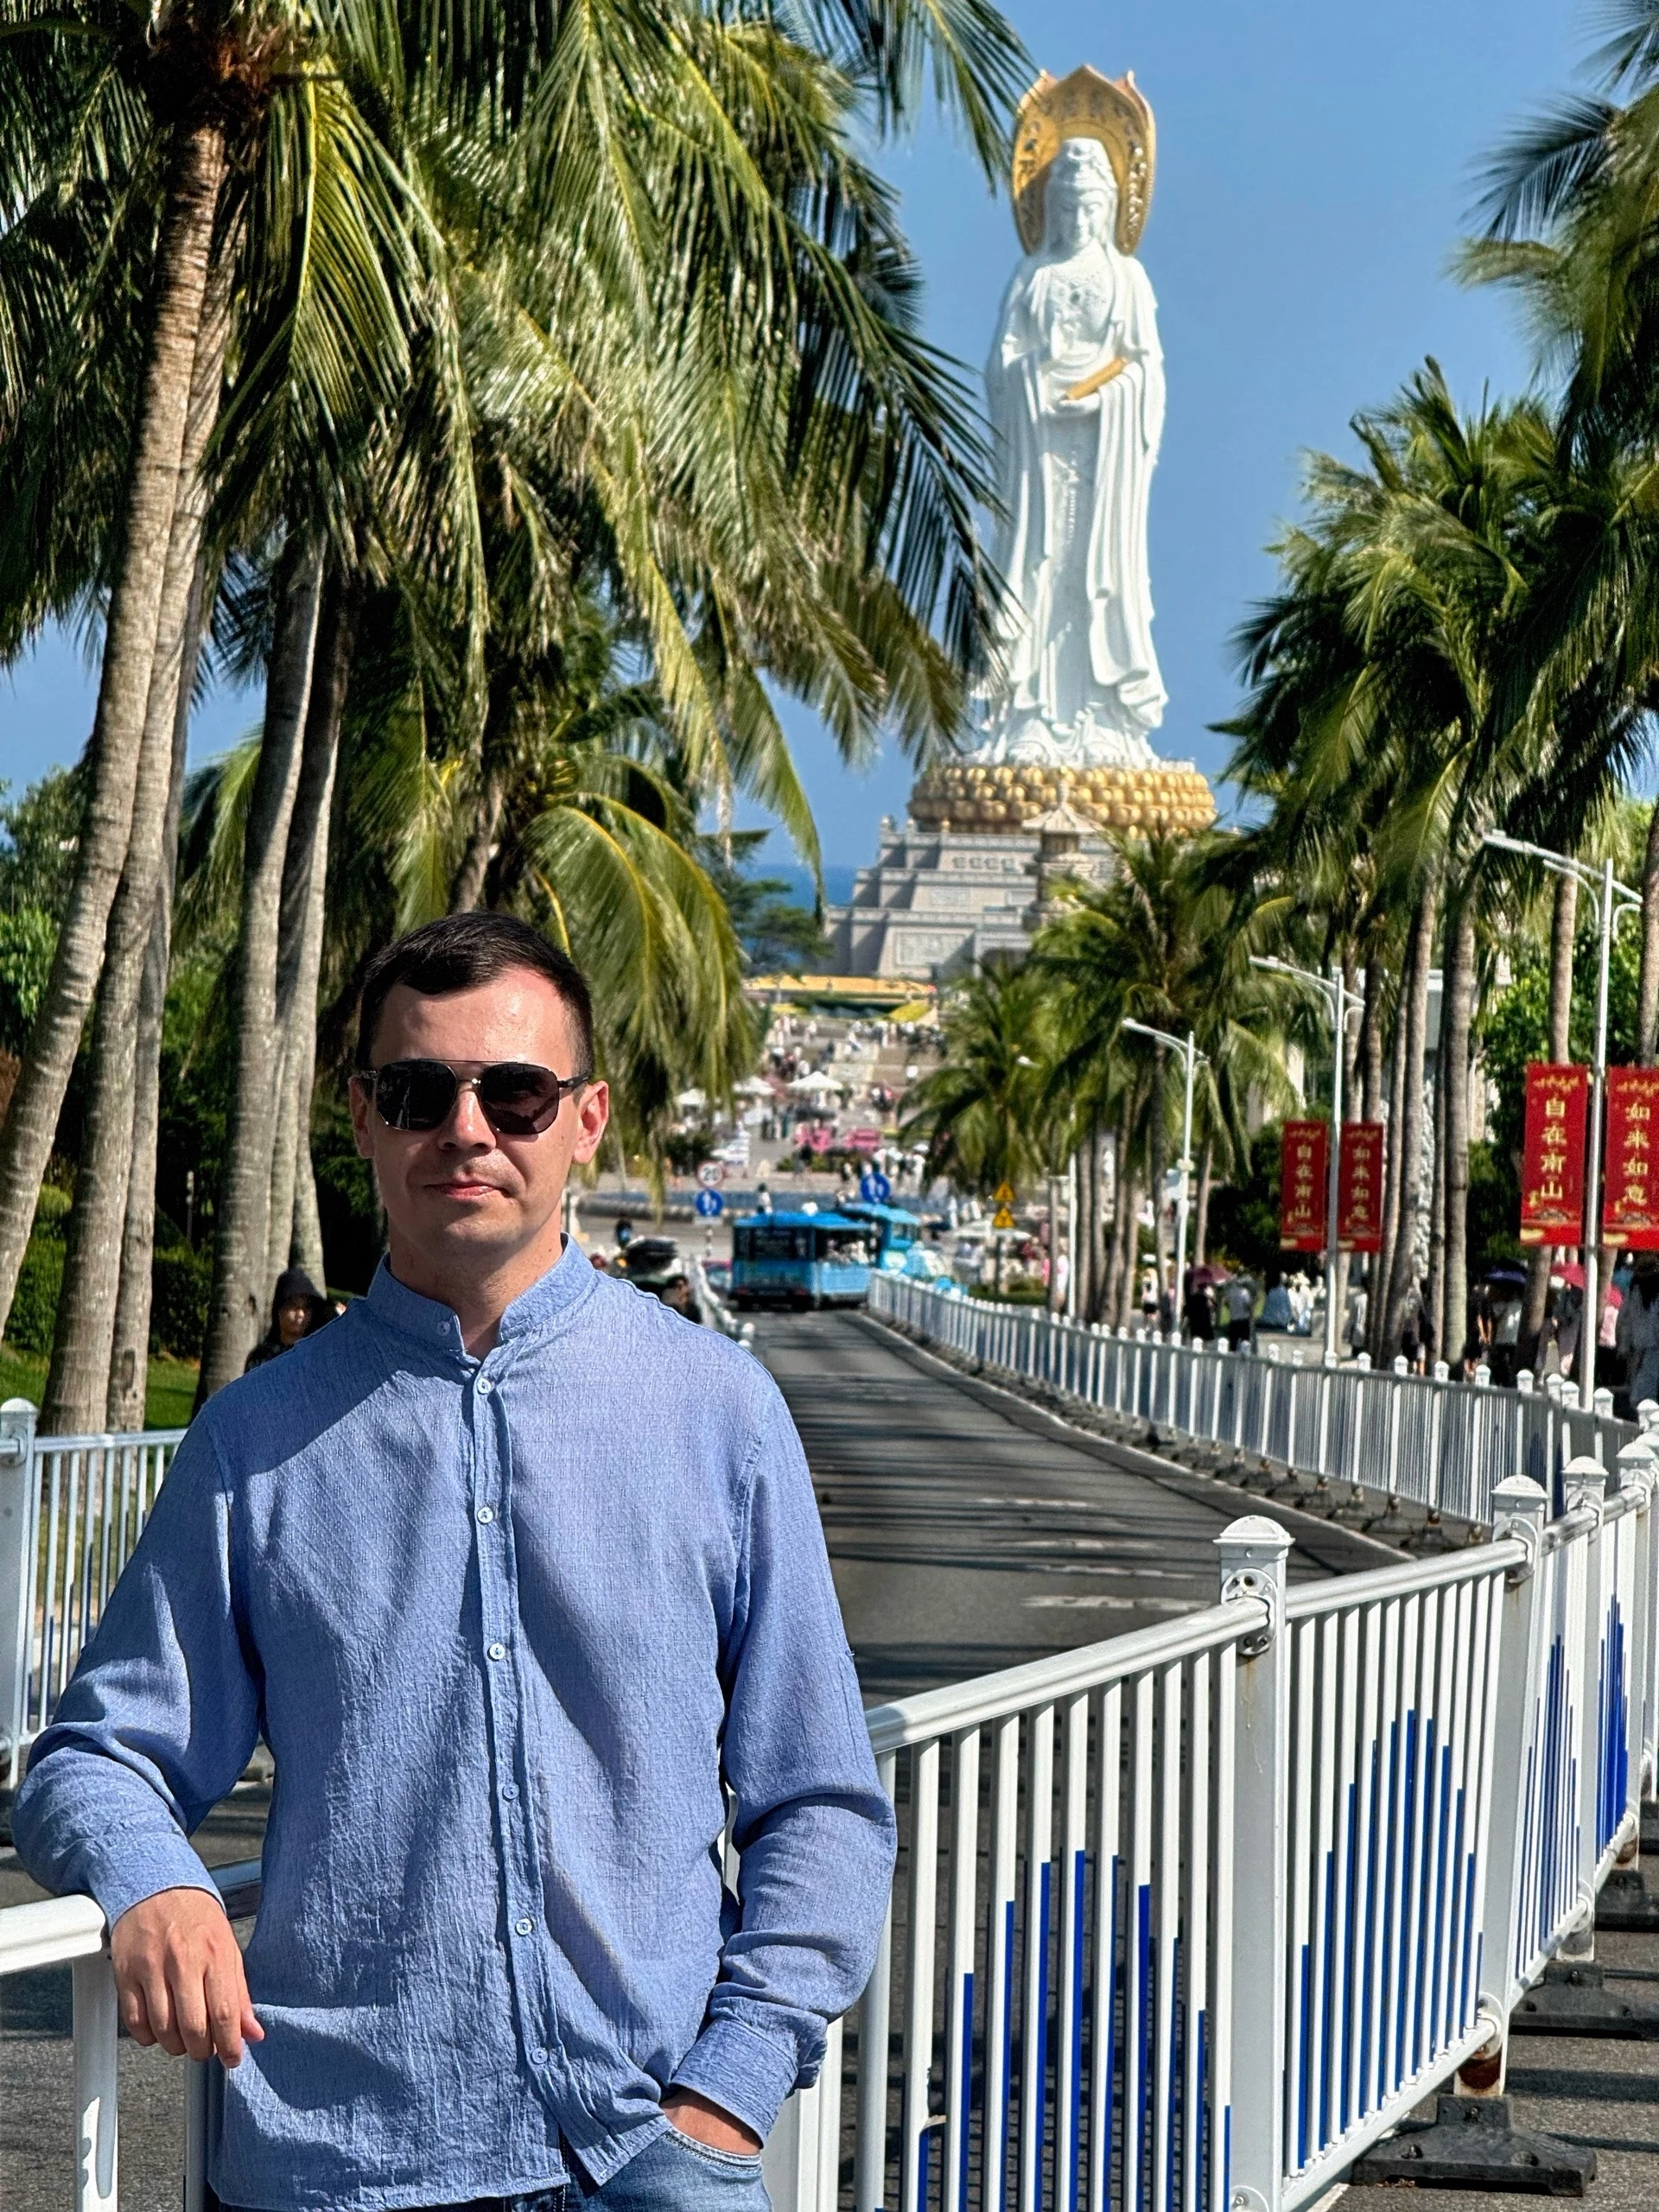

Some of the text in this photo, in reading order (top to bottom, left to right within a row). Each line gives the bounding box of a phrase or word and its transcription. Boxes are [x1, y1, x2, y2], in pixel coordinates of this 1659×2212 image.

[1294, 1144, 1313, 1217] 自在南山
[1541, 1097, 1567, 1199] 自在南山
